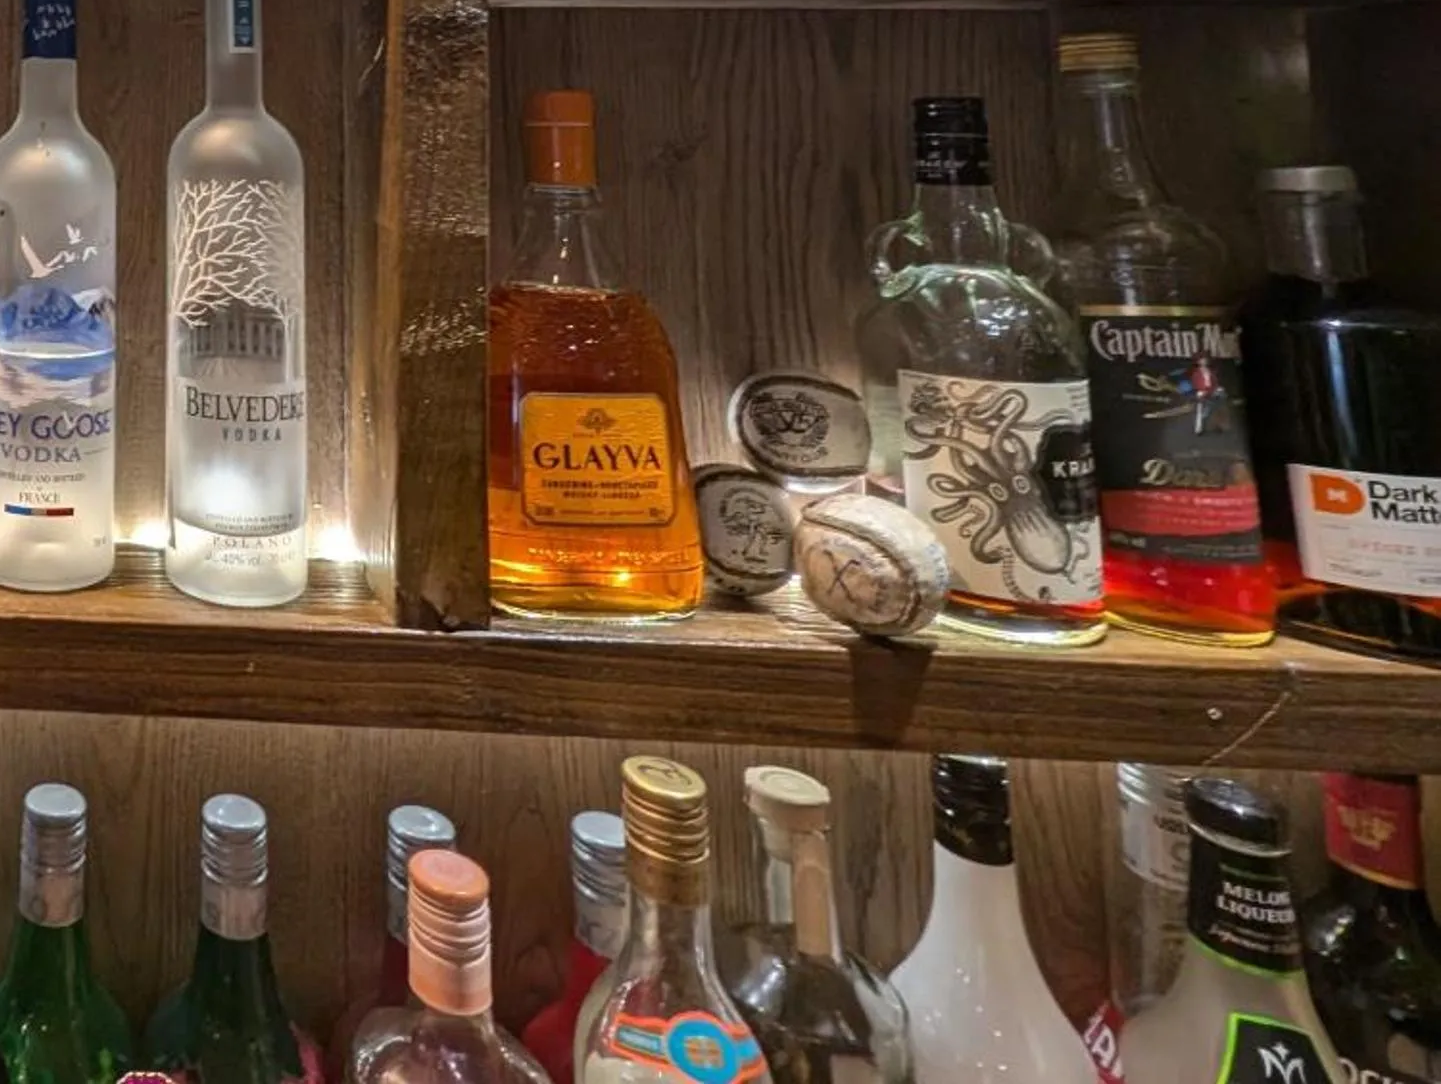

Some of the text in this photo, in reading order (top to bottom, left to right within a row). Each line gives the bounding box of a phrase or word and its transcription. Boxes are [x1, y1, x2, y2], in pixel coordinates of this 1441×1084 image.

[1090, 319, 1197, 363] Captain
[30, 411, 112, 440] GOOSE
[221, 427, 282, 442] VODKA
[0, 441, 82, 463] VODKA
[532, 441, 662, 472] GLAYVA
[1368, 480, 1440, 503] Dark
[211, 536, 293, 551] POLAND
